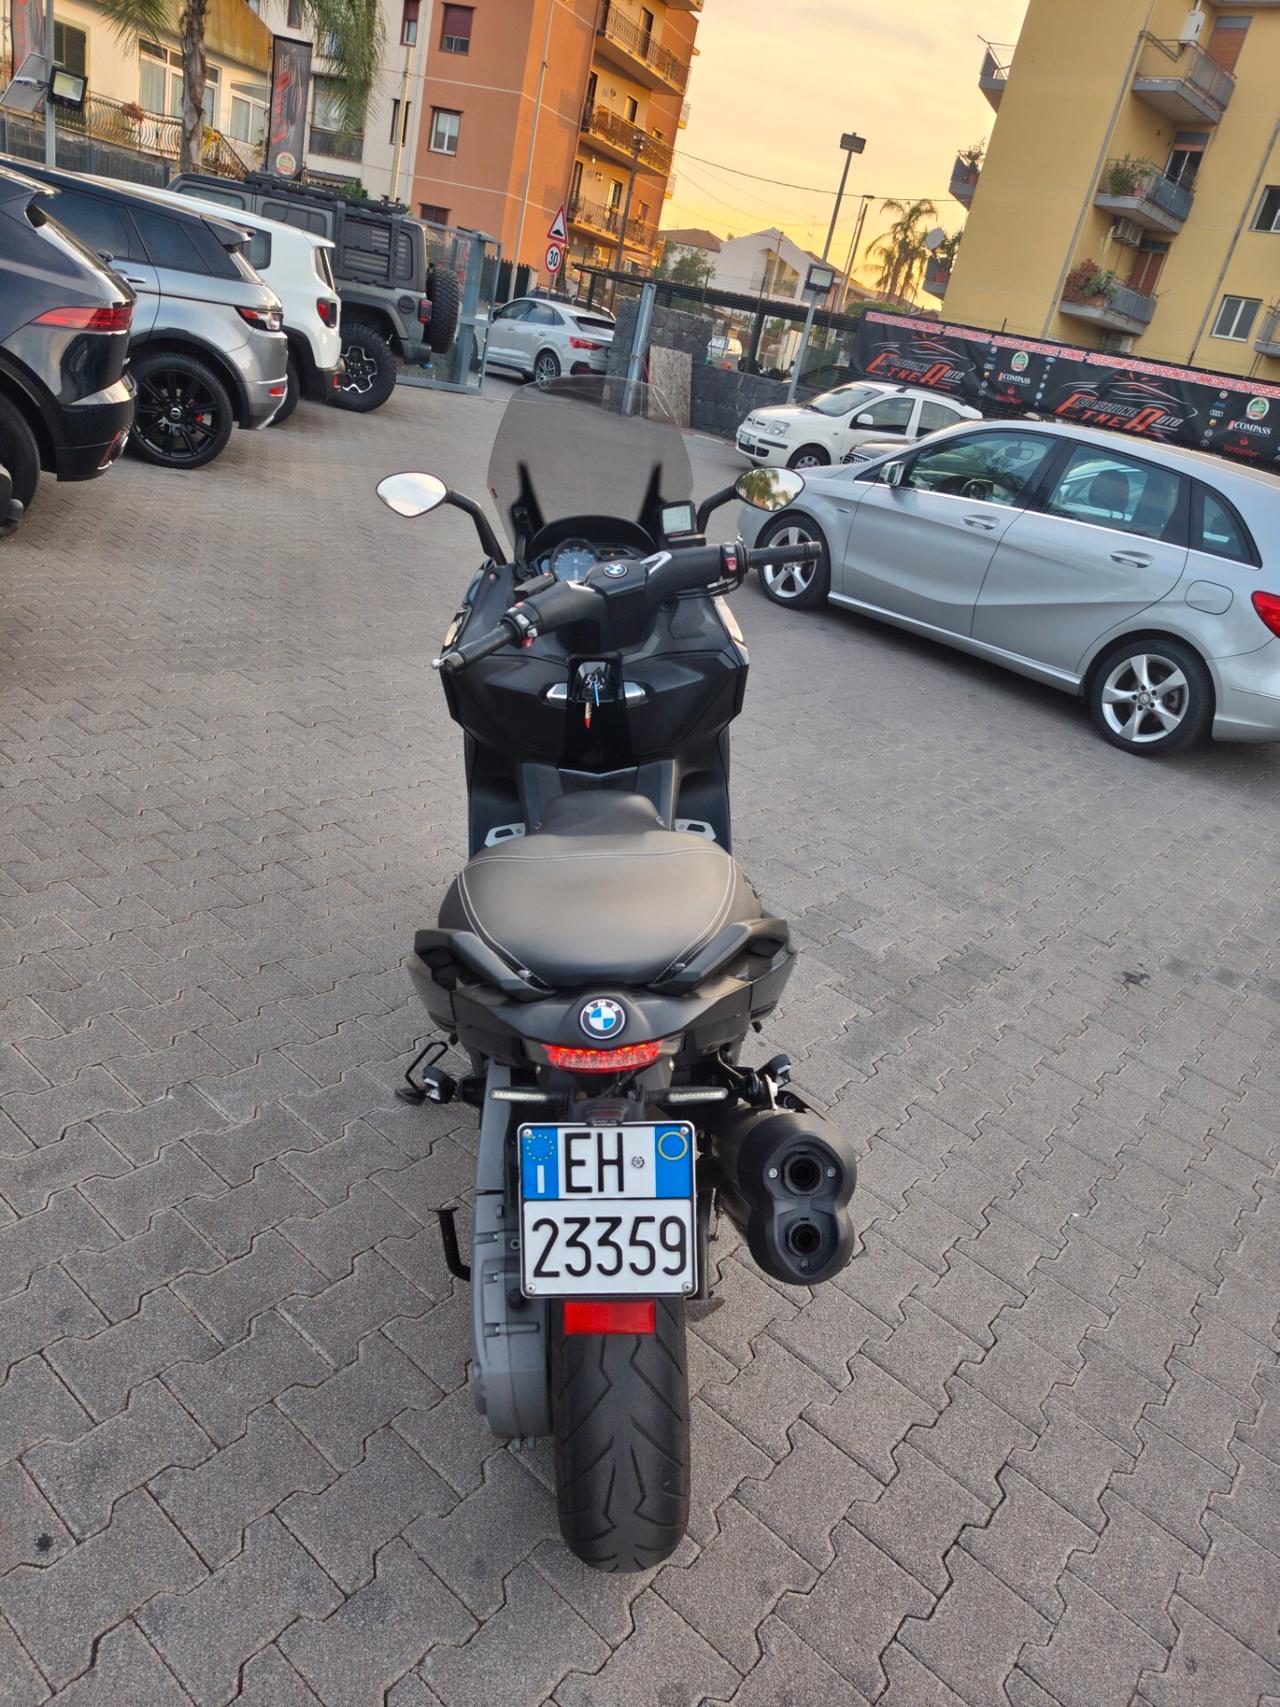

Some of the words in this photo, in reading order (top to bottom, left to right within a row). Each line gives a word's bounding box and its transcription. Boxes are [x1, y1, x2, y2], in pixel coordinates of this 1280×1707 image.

[548, 250, 559, 267] 30
[1002, 373, 1032, 385] COMPASS
[1234, 421, 1272, 435] COMPASS
[564, 1132, 625, 1193] EH
[532, 1215, 687, 1278] 23359
